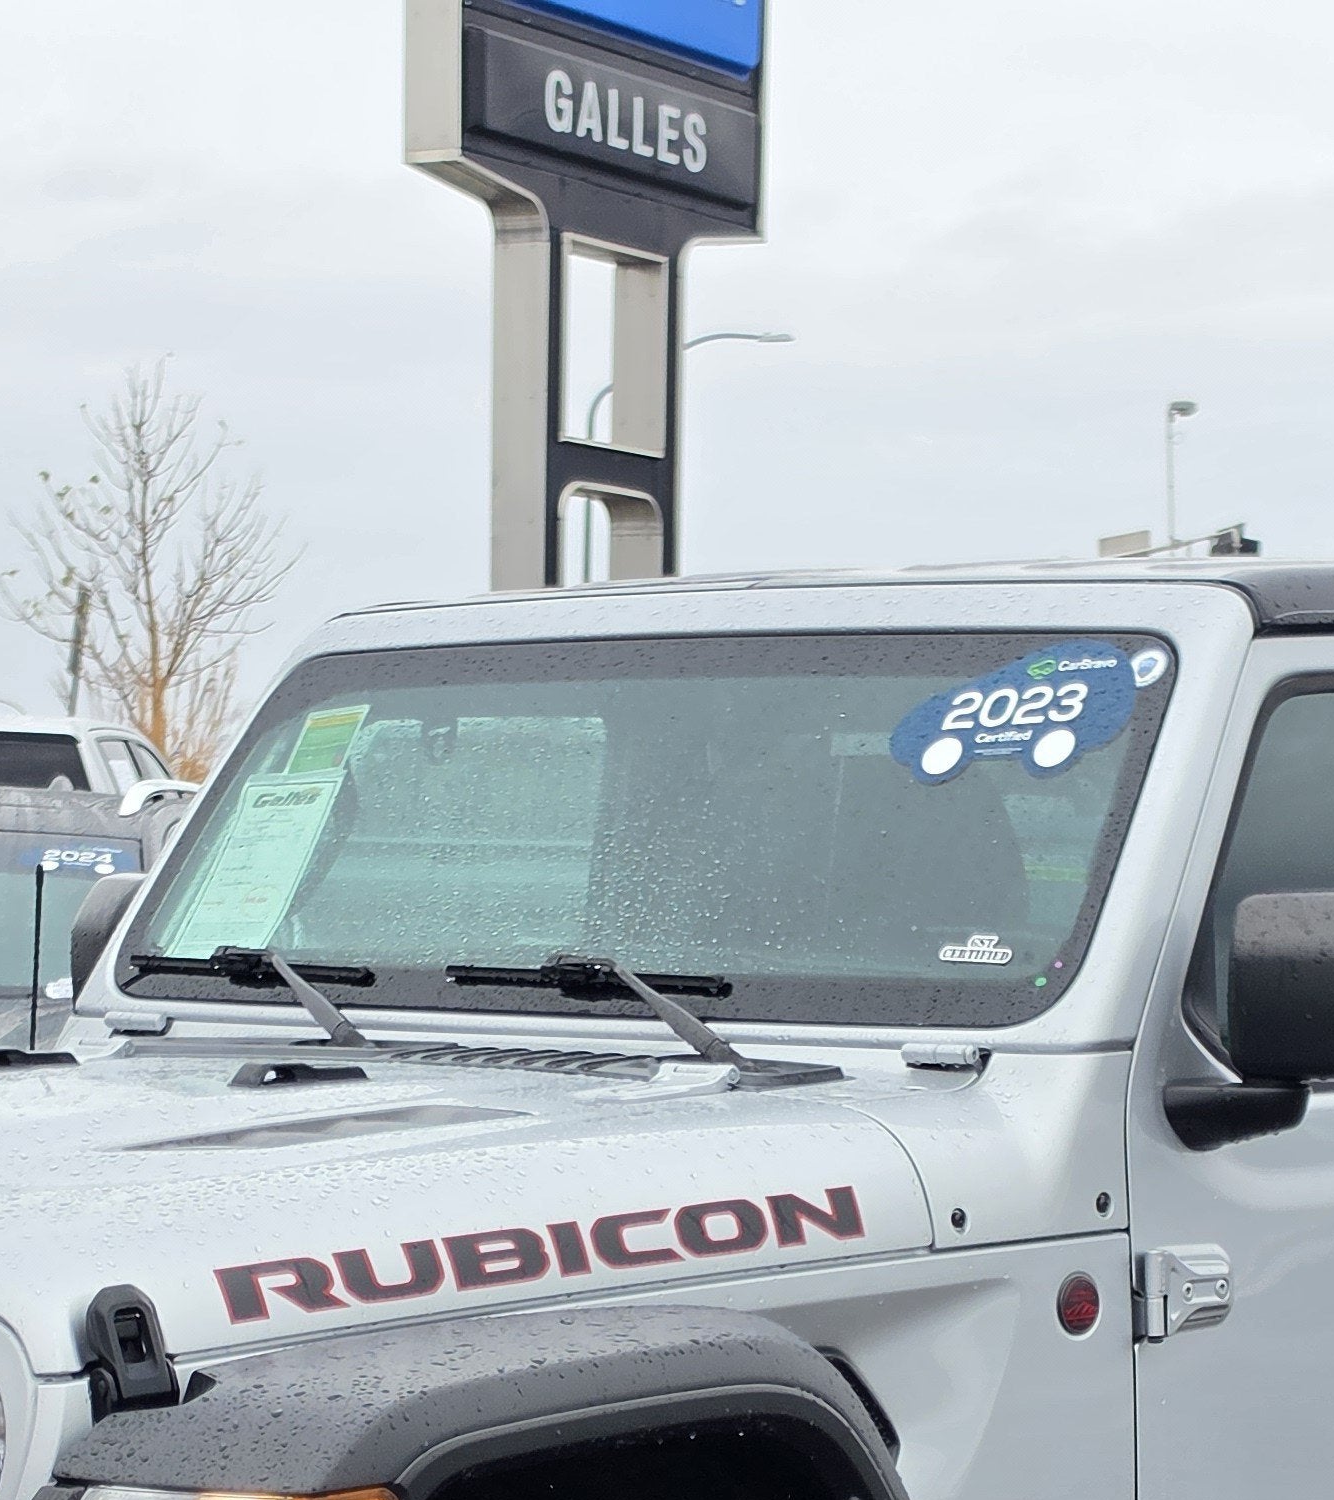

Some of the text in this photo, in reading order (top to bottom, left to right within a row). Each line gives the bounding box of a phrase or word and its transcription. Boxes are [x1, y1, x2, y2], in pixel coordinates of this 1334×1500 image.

[545, 70, 707, 173] GALLES
[942, 683, 1088, 731] 2023
[975, 730, 1033, 744] Certified
[42, 849, 112, 863] 2024
[943, 948, 1010, 961] CERTIFIED
[213, 1186, 866, 1325] RUBICON
